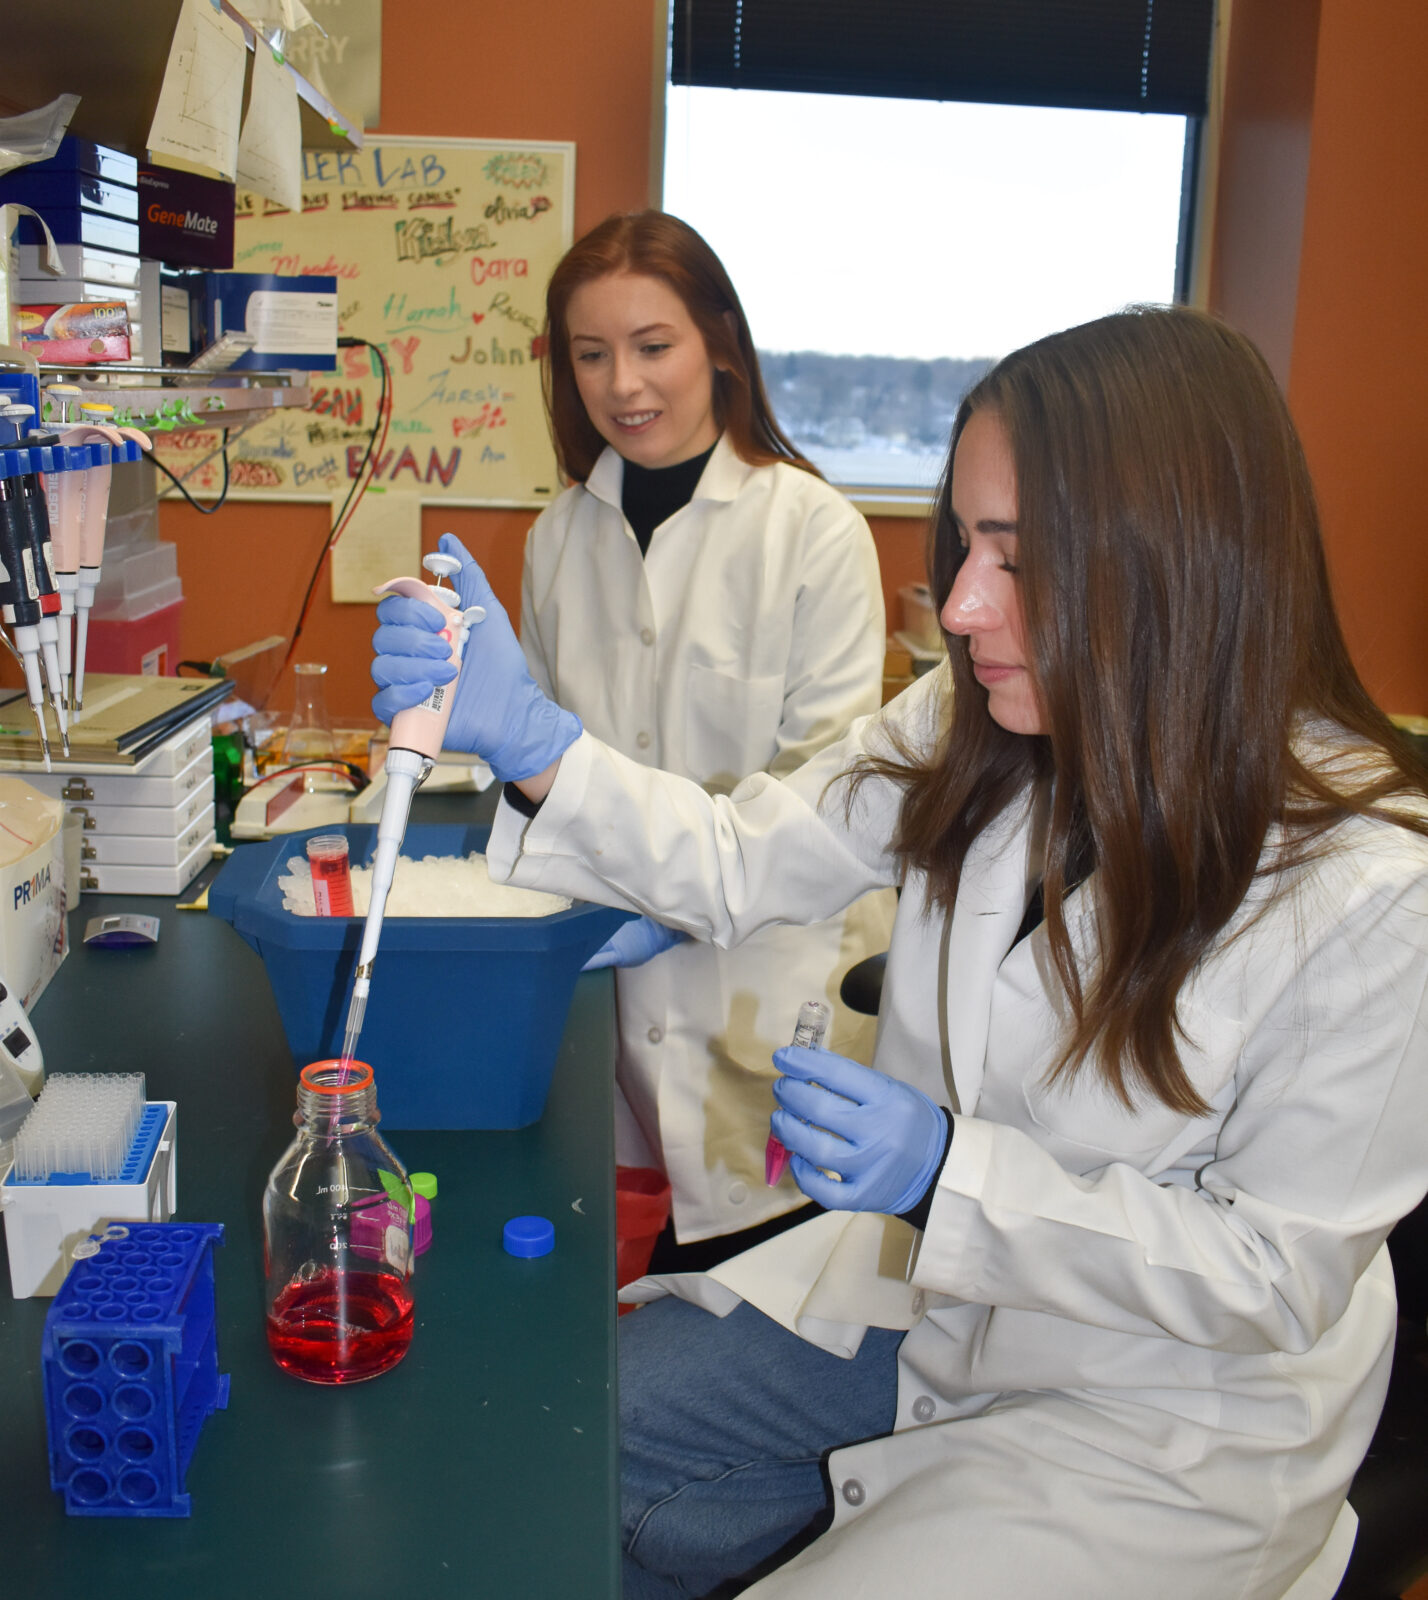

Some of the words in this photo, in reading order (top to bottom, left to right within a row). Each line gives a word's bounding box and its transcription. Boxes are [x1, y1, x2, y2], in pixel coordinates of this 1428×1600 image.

[147, 203, 218, 234] GeneMate
[471, 257, 528, 286] Cara
[450, 336, 524, 366] John
[293, 455, 339, 487] Brett
[346, 446, 462, 487] EVAN
